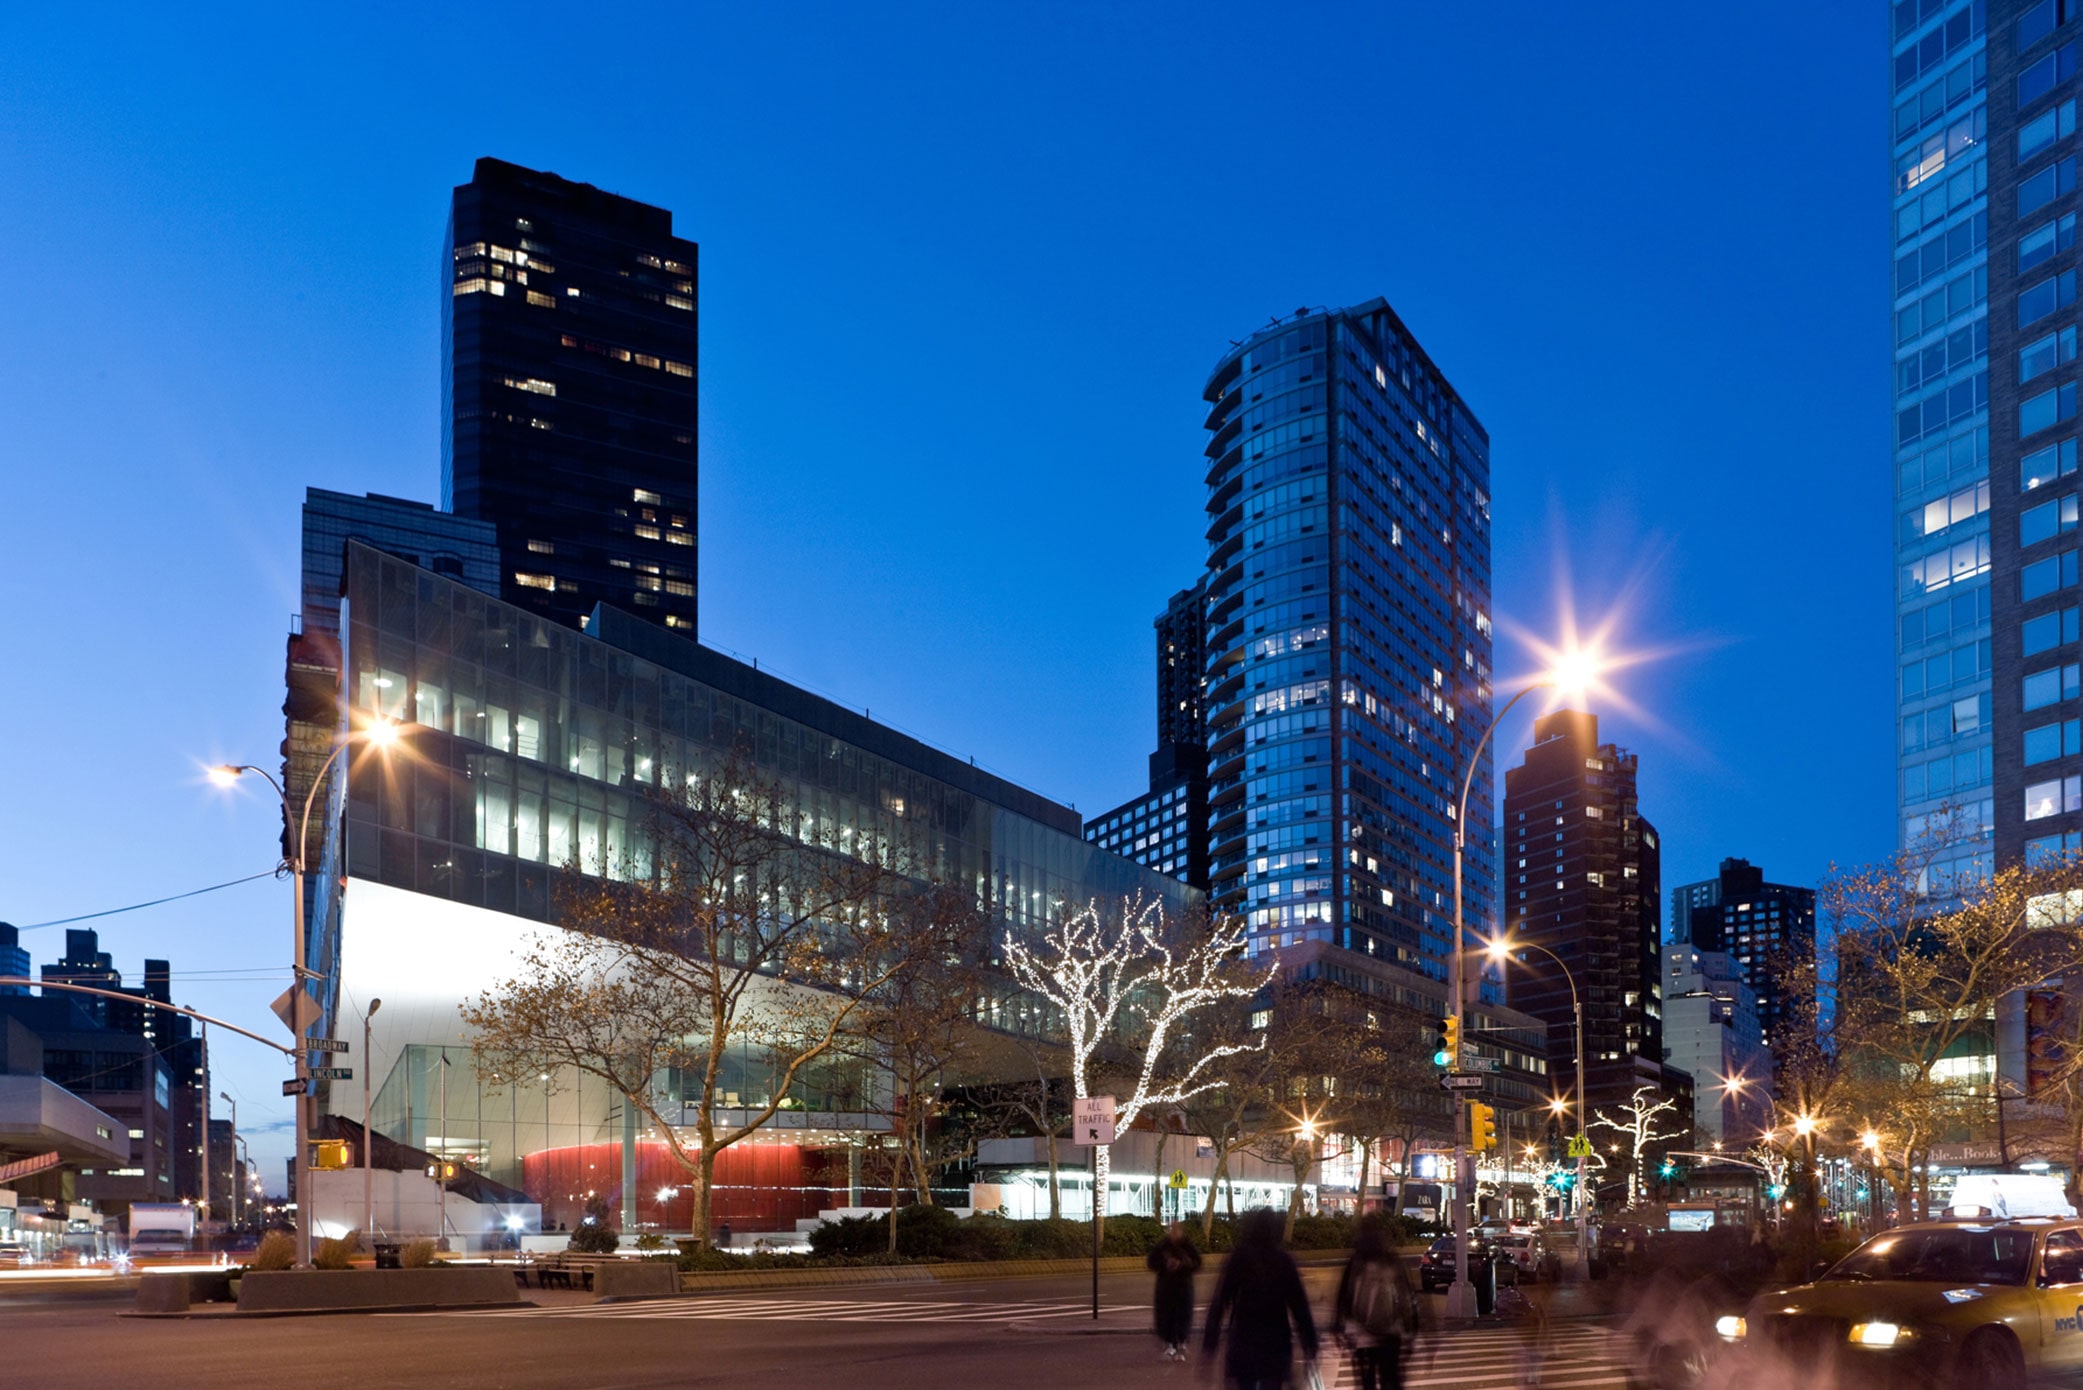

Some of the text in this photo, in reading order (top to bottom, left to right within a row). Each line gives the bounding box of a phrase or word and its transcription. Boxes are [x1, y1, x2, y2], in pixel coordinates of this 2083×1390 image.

[308, 1039, 346, 1051] BROADWAY
[310, 1069, 342, 1079] LINCOLN
[1445, 1078, 1458, 1086] ONE
[1087, 1102, 1102, 1111] ALL
[1078, 1114, 1111, 1124] TRAFFIC
[1417, 1194, 1432, 1205] ZARA
[2055, 1317, 2076, 1331] NYC
